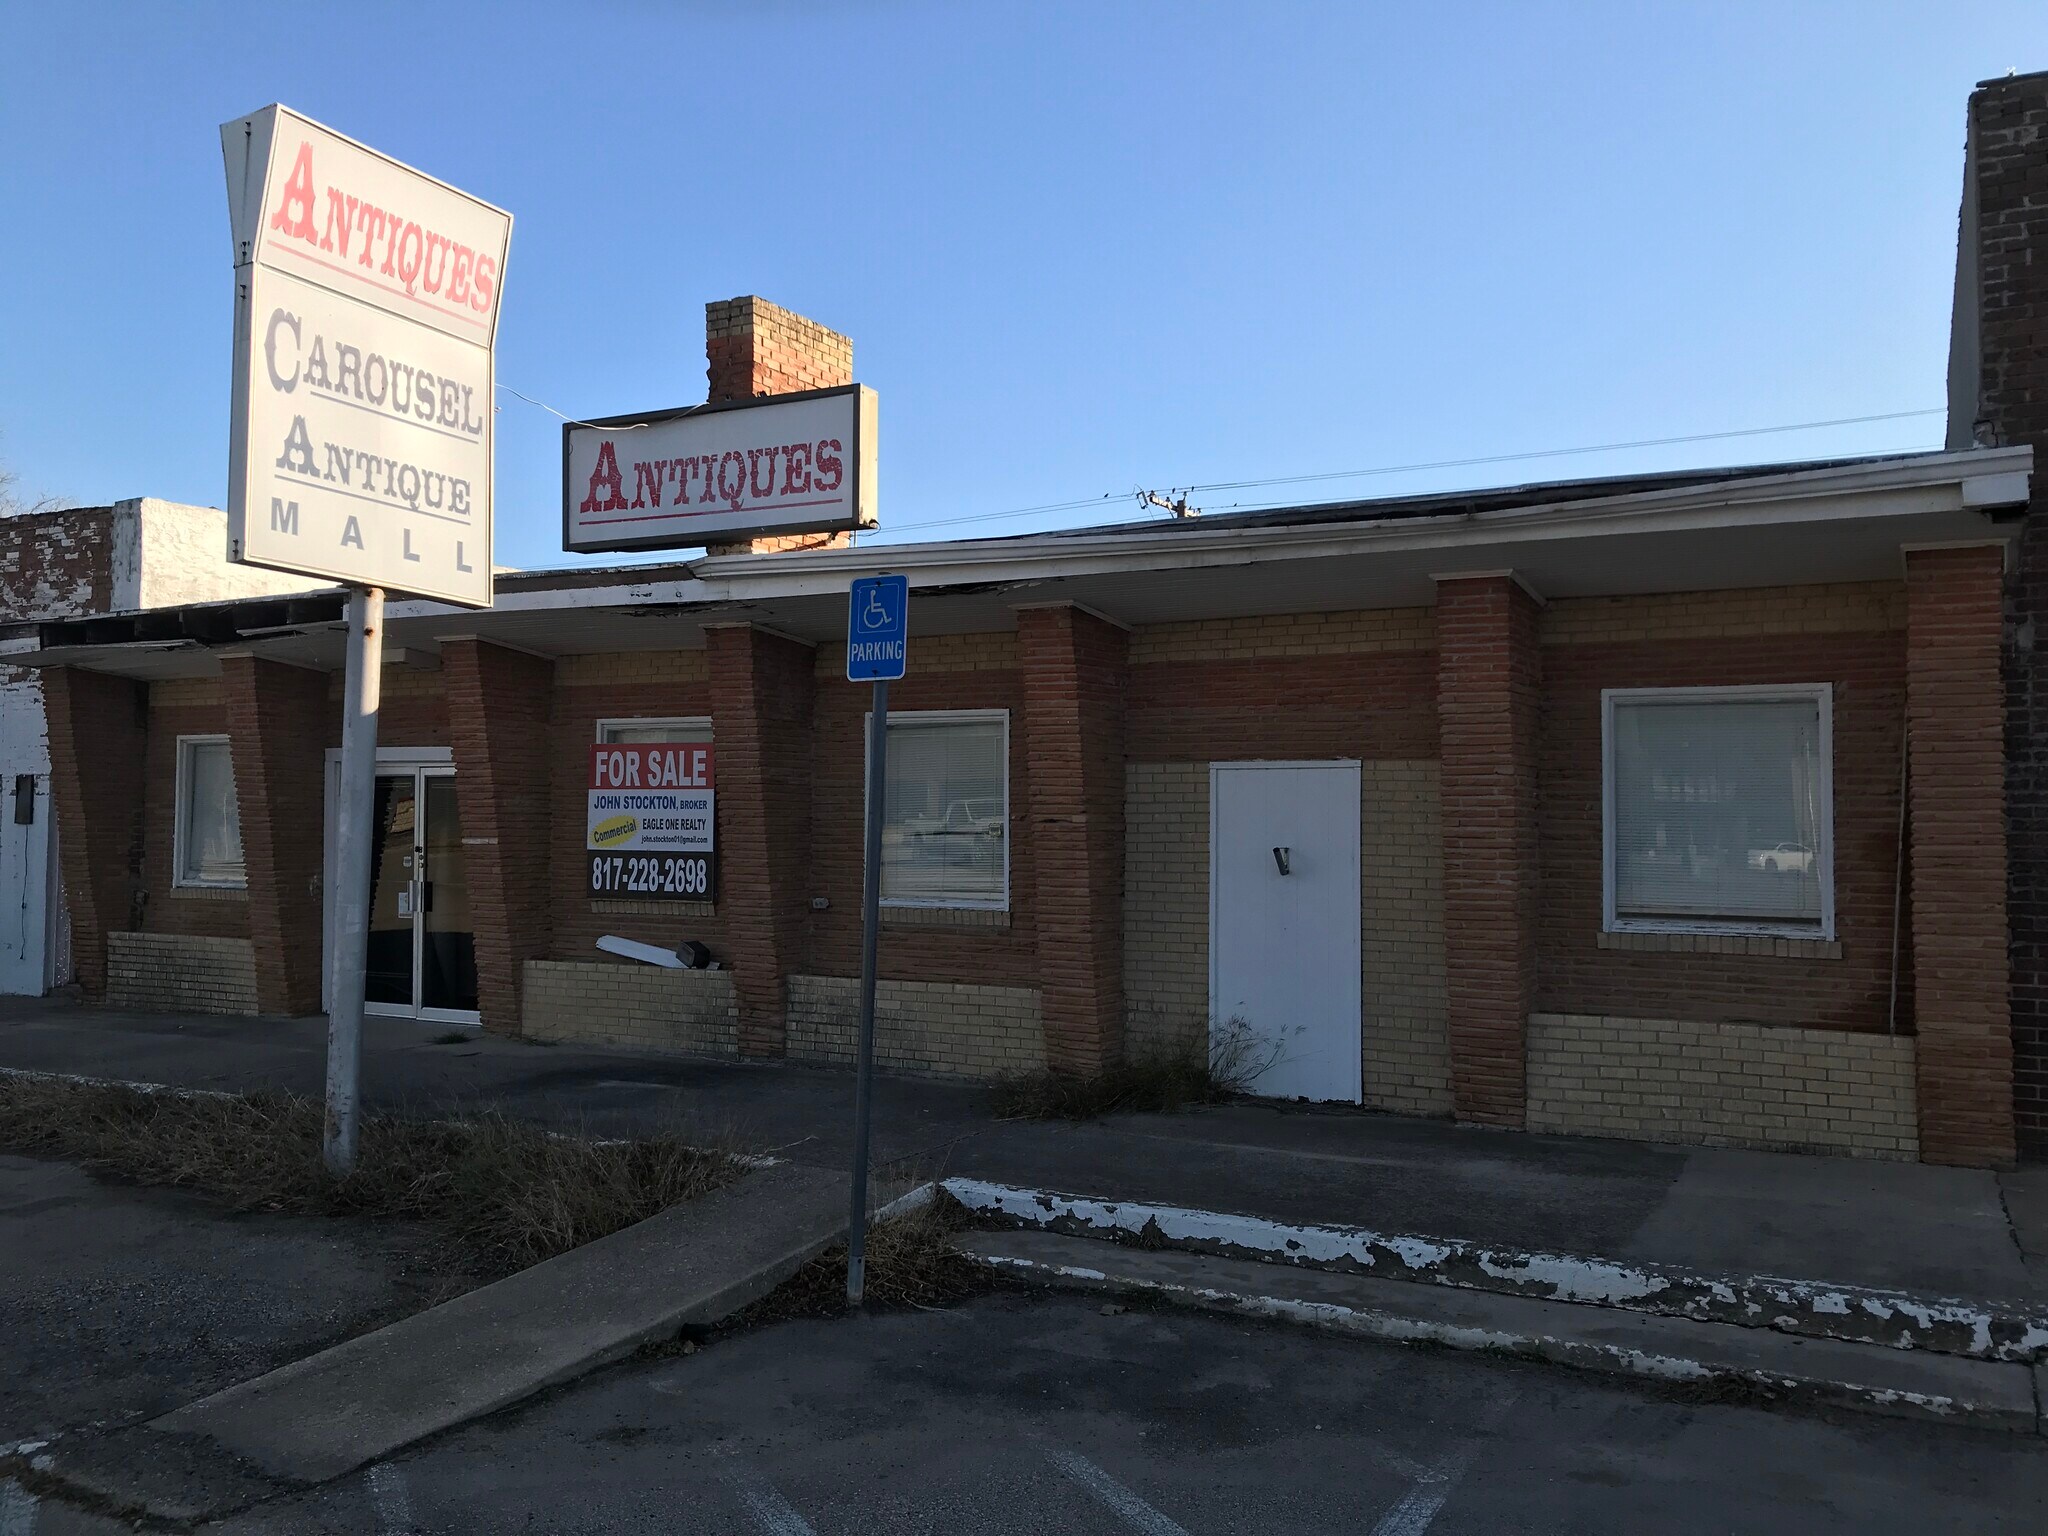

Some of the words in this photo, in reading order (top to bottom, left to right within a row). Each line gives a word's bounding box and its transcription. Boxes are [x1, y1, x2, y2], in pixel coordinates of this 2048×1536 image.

[263, 307, 483, 436] CAROUSEL
[275, 414, 471, 516] ANTIQUE
[579, 438, 843, 513] ANTIQUES
[851, 640, 903, 662] PARKING
[595, 751, 641, 787] FOR
[647, 750, 707, 787] SALE
[594, 796, 621, 810] JOHN
[623, 796, 679, 811] STOCKTON,
[680, 800, 708, 810] BROKER
[593, 820, 637, 844] Commercial
[642, 818, 664, 831] EAGLE
[665, 819, 680, 831] ONE
[680, 818, 707, 831] REALTY
[592, 857, 707, 893] 817-228-2698
